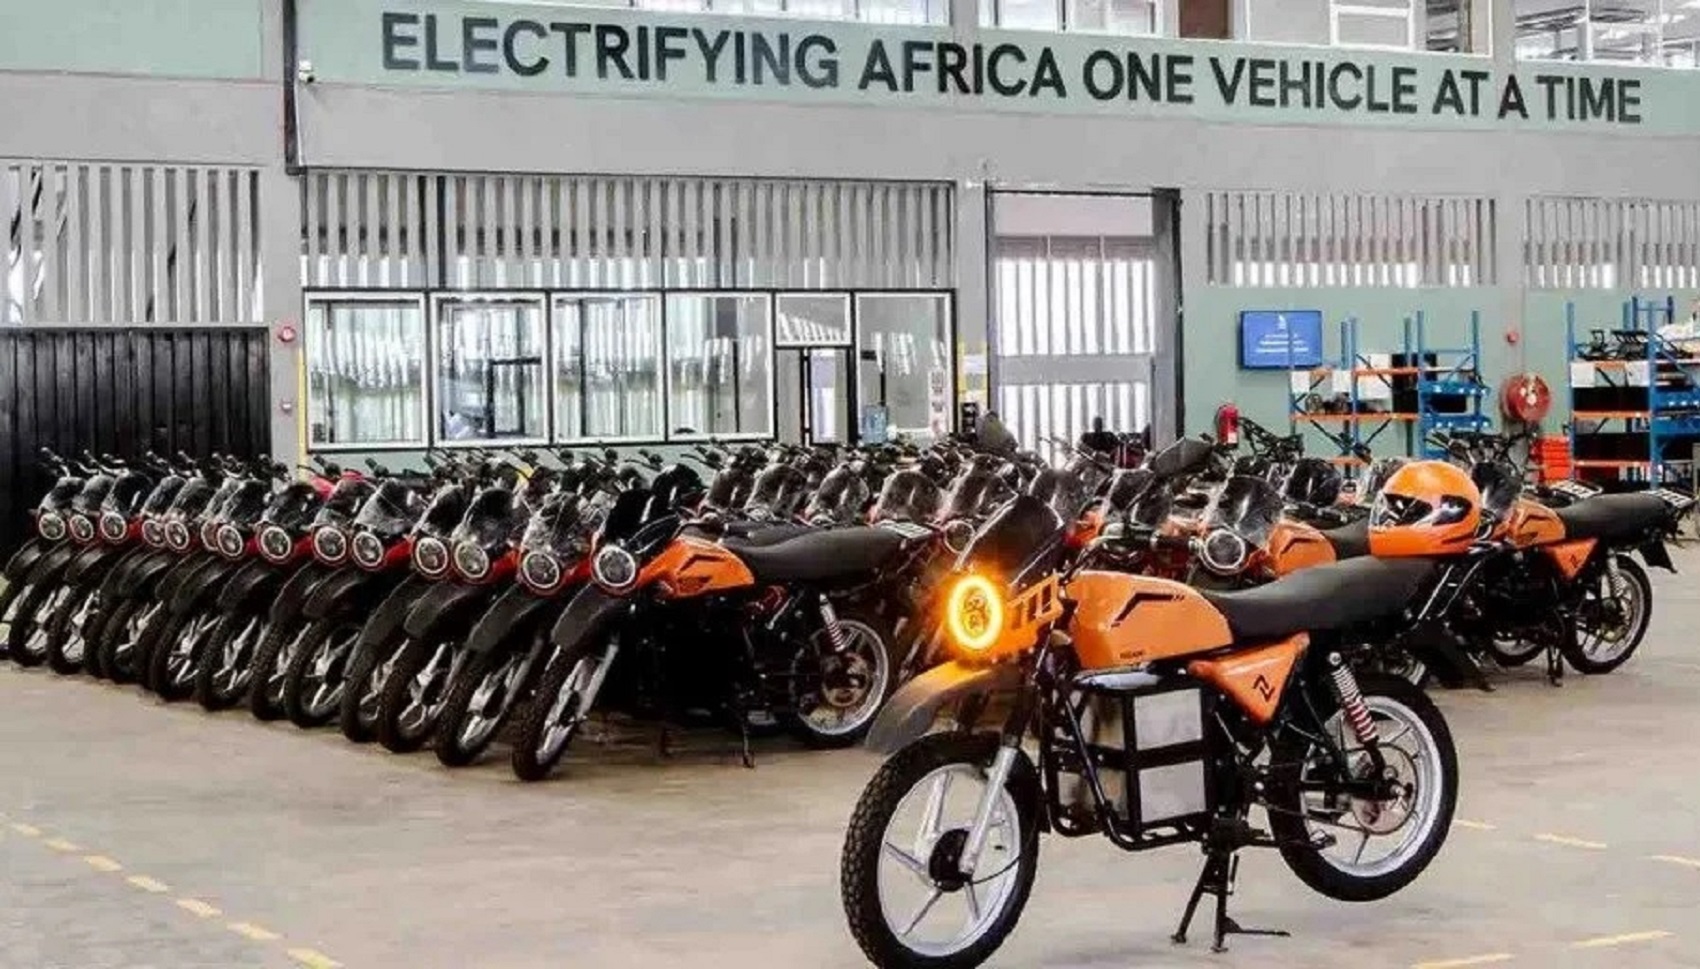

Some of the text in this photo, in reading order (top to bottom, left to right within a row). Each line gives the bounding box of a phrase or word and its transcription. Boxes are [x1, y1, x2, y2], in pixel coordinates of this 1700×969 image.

[382, 12, 1642, 123] ELECTRIFYING AFRICA ONE VEHICLE AT A TIME
